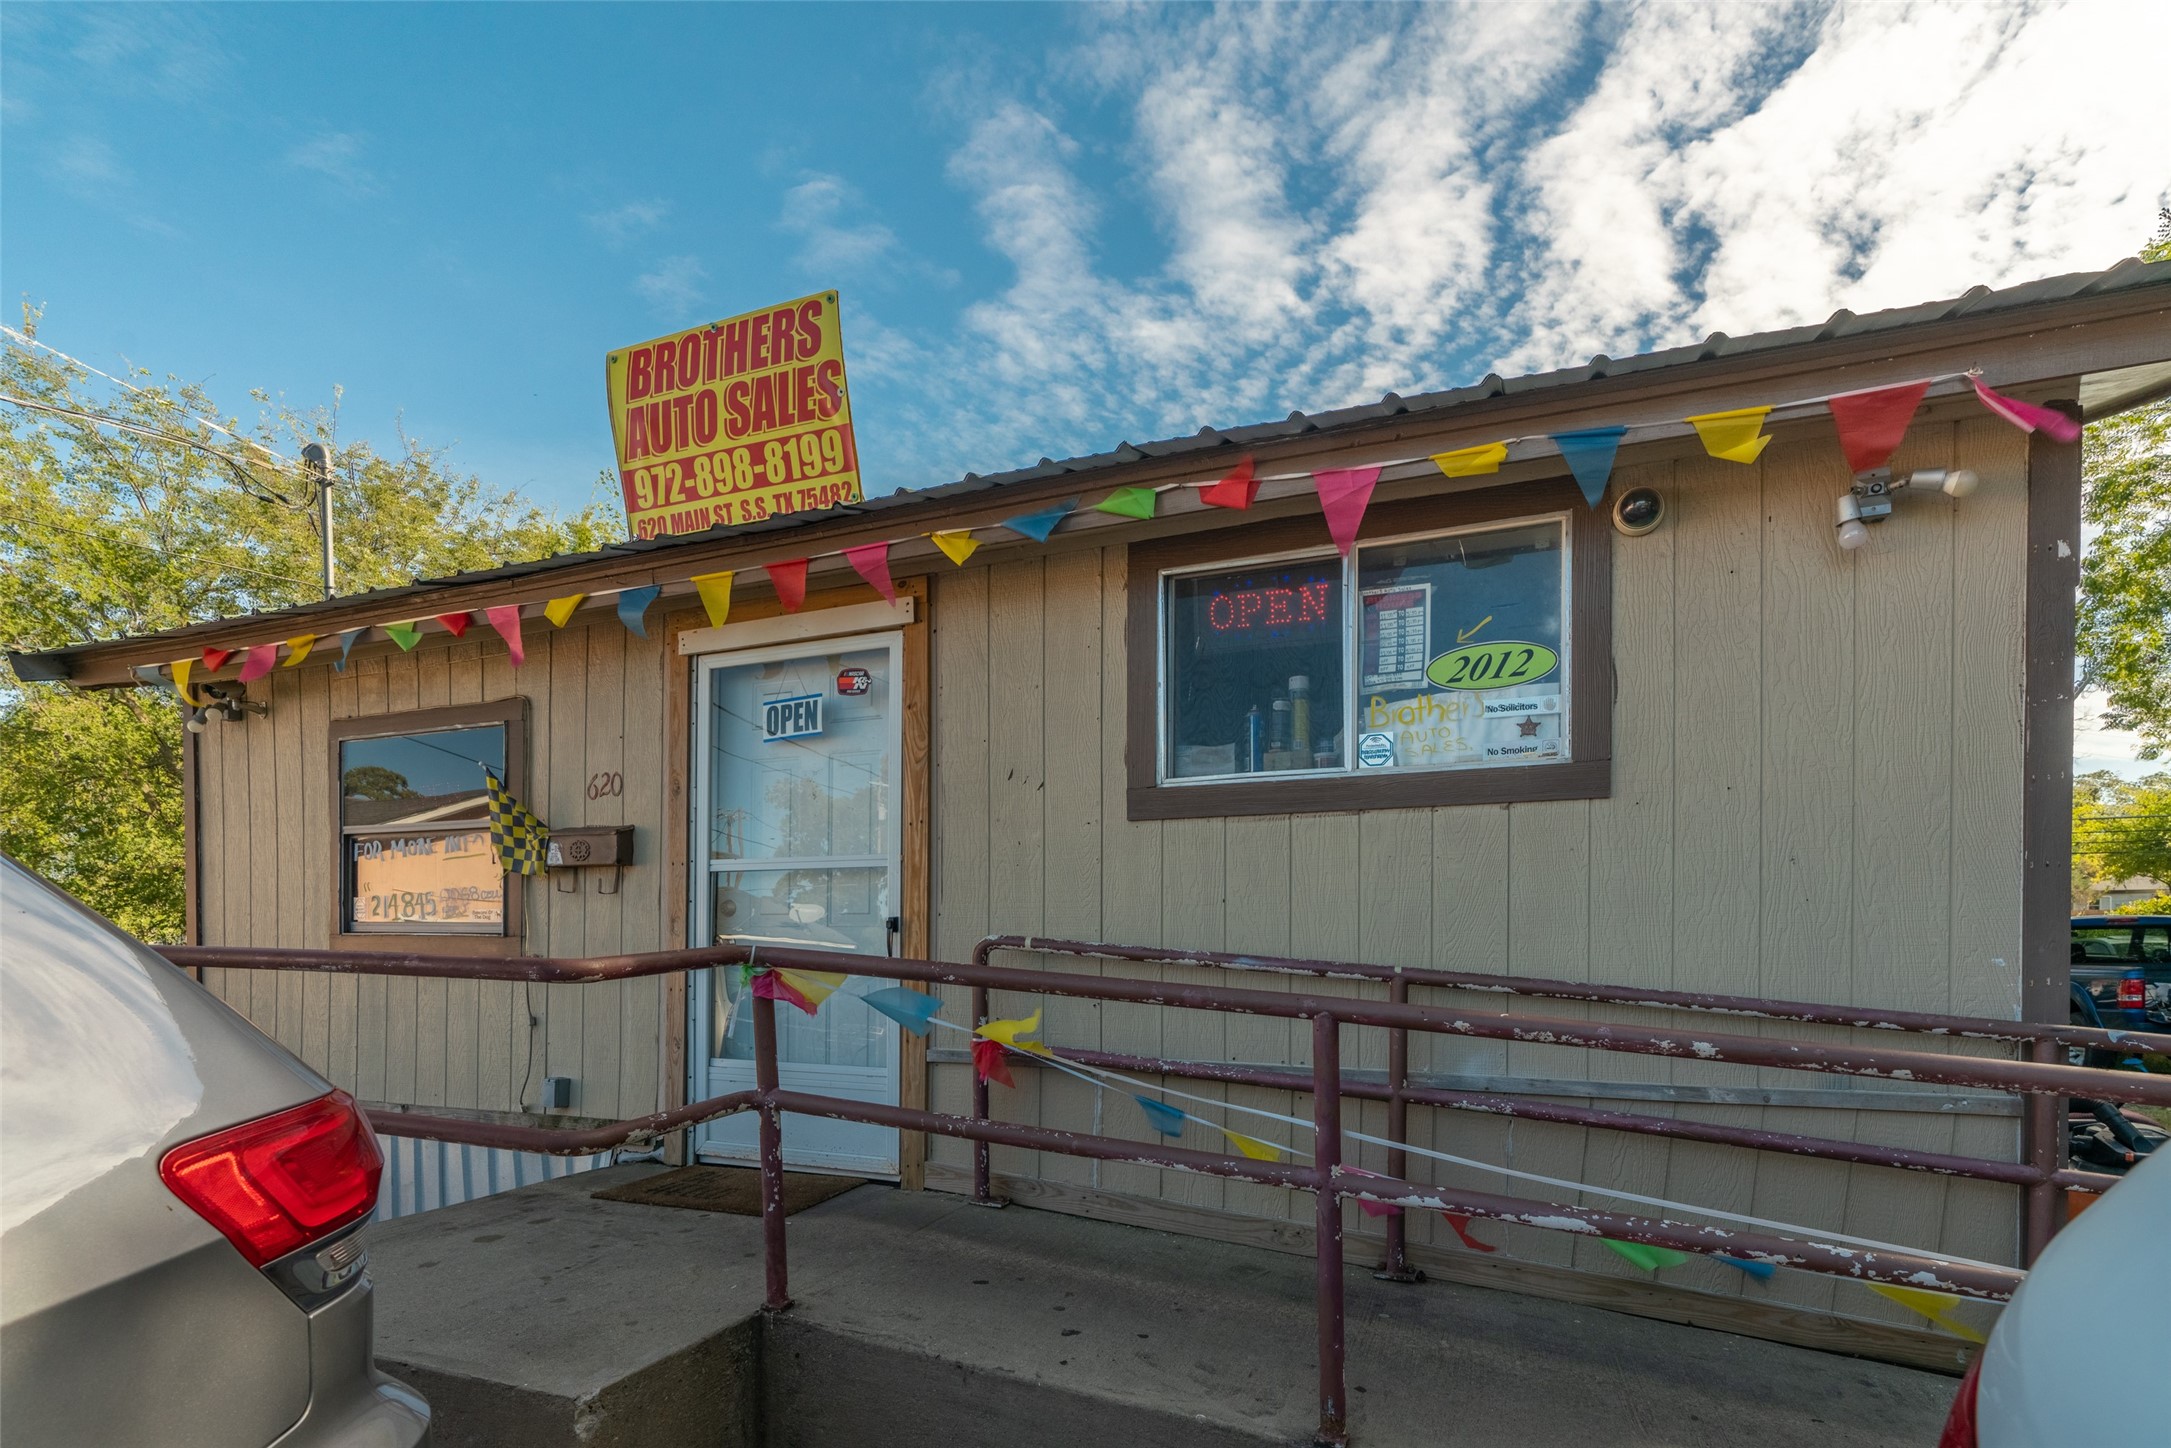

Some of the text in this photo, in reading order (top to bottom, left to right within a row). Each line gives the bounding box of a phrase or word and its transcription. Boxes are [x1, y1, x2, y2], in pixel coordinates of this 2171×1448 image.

[626, 300, 822, 404] BROTHERS
[624, 359, 843, 465] AUTO SALES
[633, 428, 845, 509] 972-898-8199
[637, 480, 853, 540] 620 MAIN ST S.S. TX 75482
[1209, 584, 1328, 631] OPEN
[1445, 648, 1534, 684] 2012
[767, 700, 818, 737] OPEN
[1486, 702, 1538, 713] No Solicitors
[1401, 726, 1451, 746] AUTO
[1487, 745, 1538, 756] No Smoking
[587, 771, 624, 800] 620
[354, 840, 385, 862] FOR
[391, 836, 437, 860] MORE
